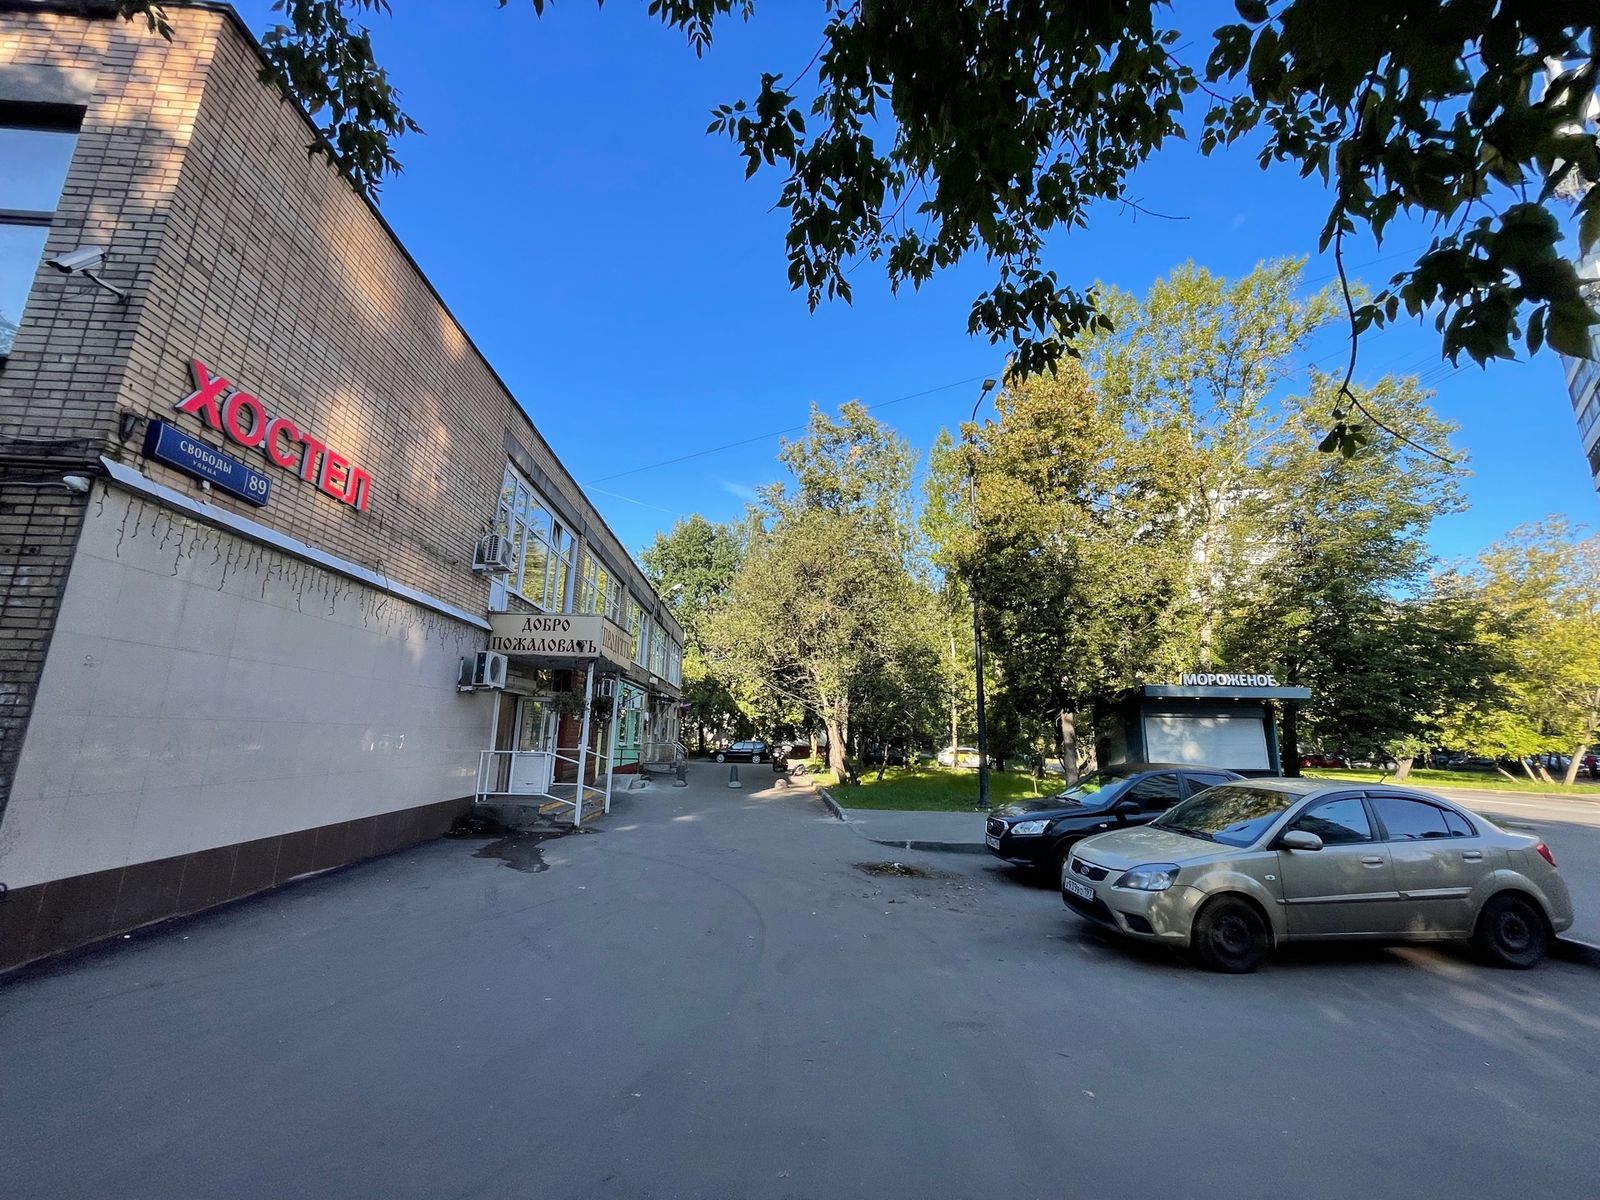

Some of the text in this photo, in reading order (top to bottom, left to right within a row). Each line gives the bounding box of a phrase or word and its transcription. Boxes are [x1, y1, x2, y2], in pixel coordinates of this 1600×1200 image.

[174, 358, 372, 513] ХОСТЕЛ
[179, 440, 232, 474] СВОБОДЫ
[192, 460, 217, 476] УЛИЦА
[249, 475, 267, 495] 89
[522, 617, 571, 633] ДОБРО
[491, 636, 597, 653] ПОЖАЛОВАТЬ
[1181, 672, 1276, 687] МОРОЖЕНОЕ
